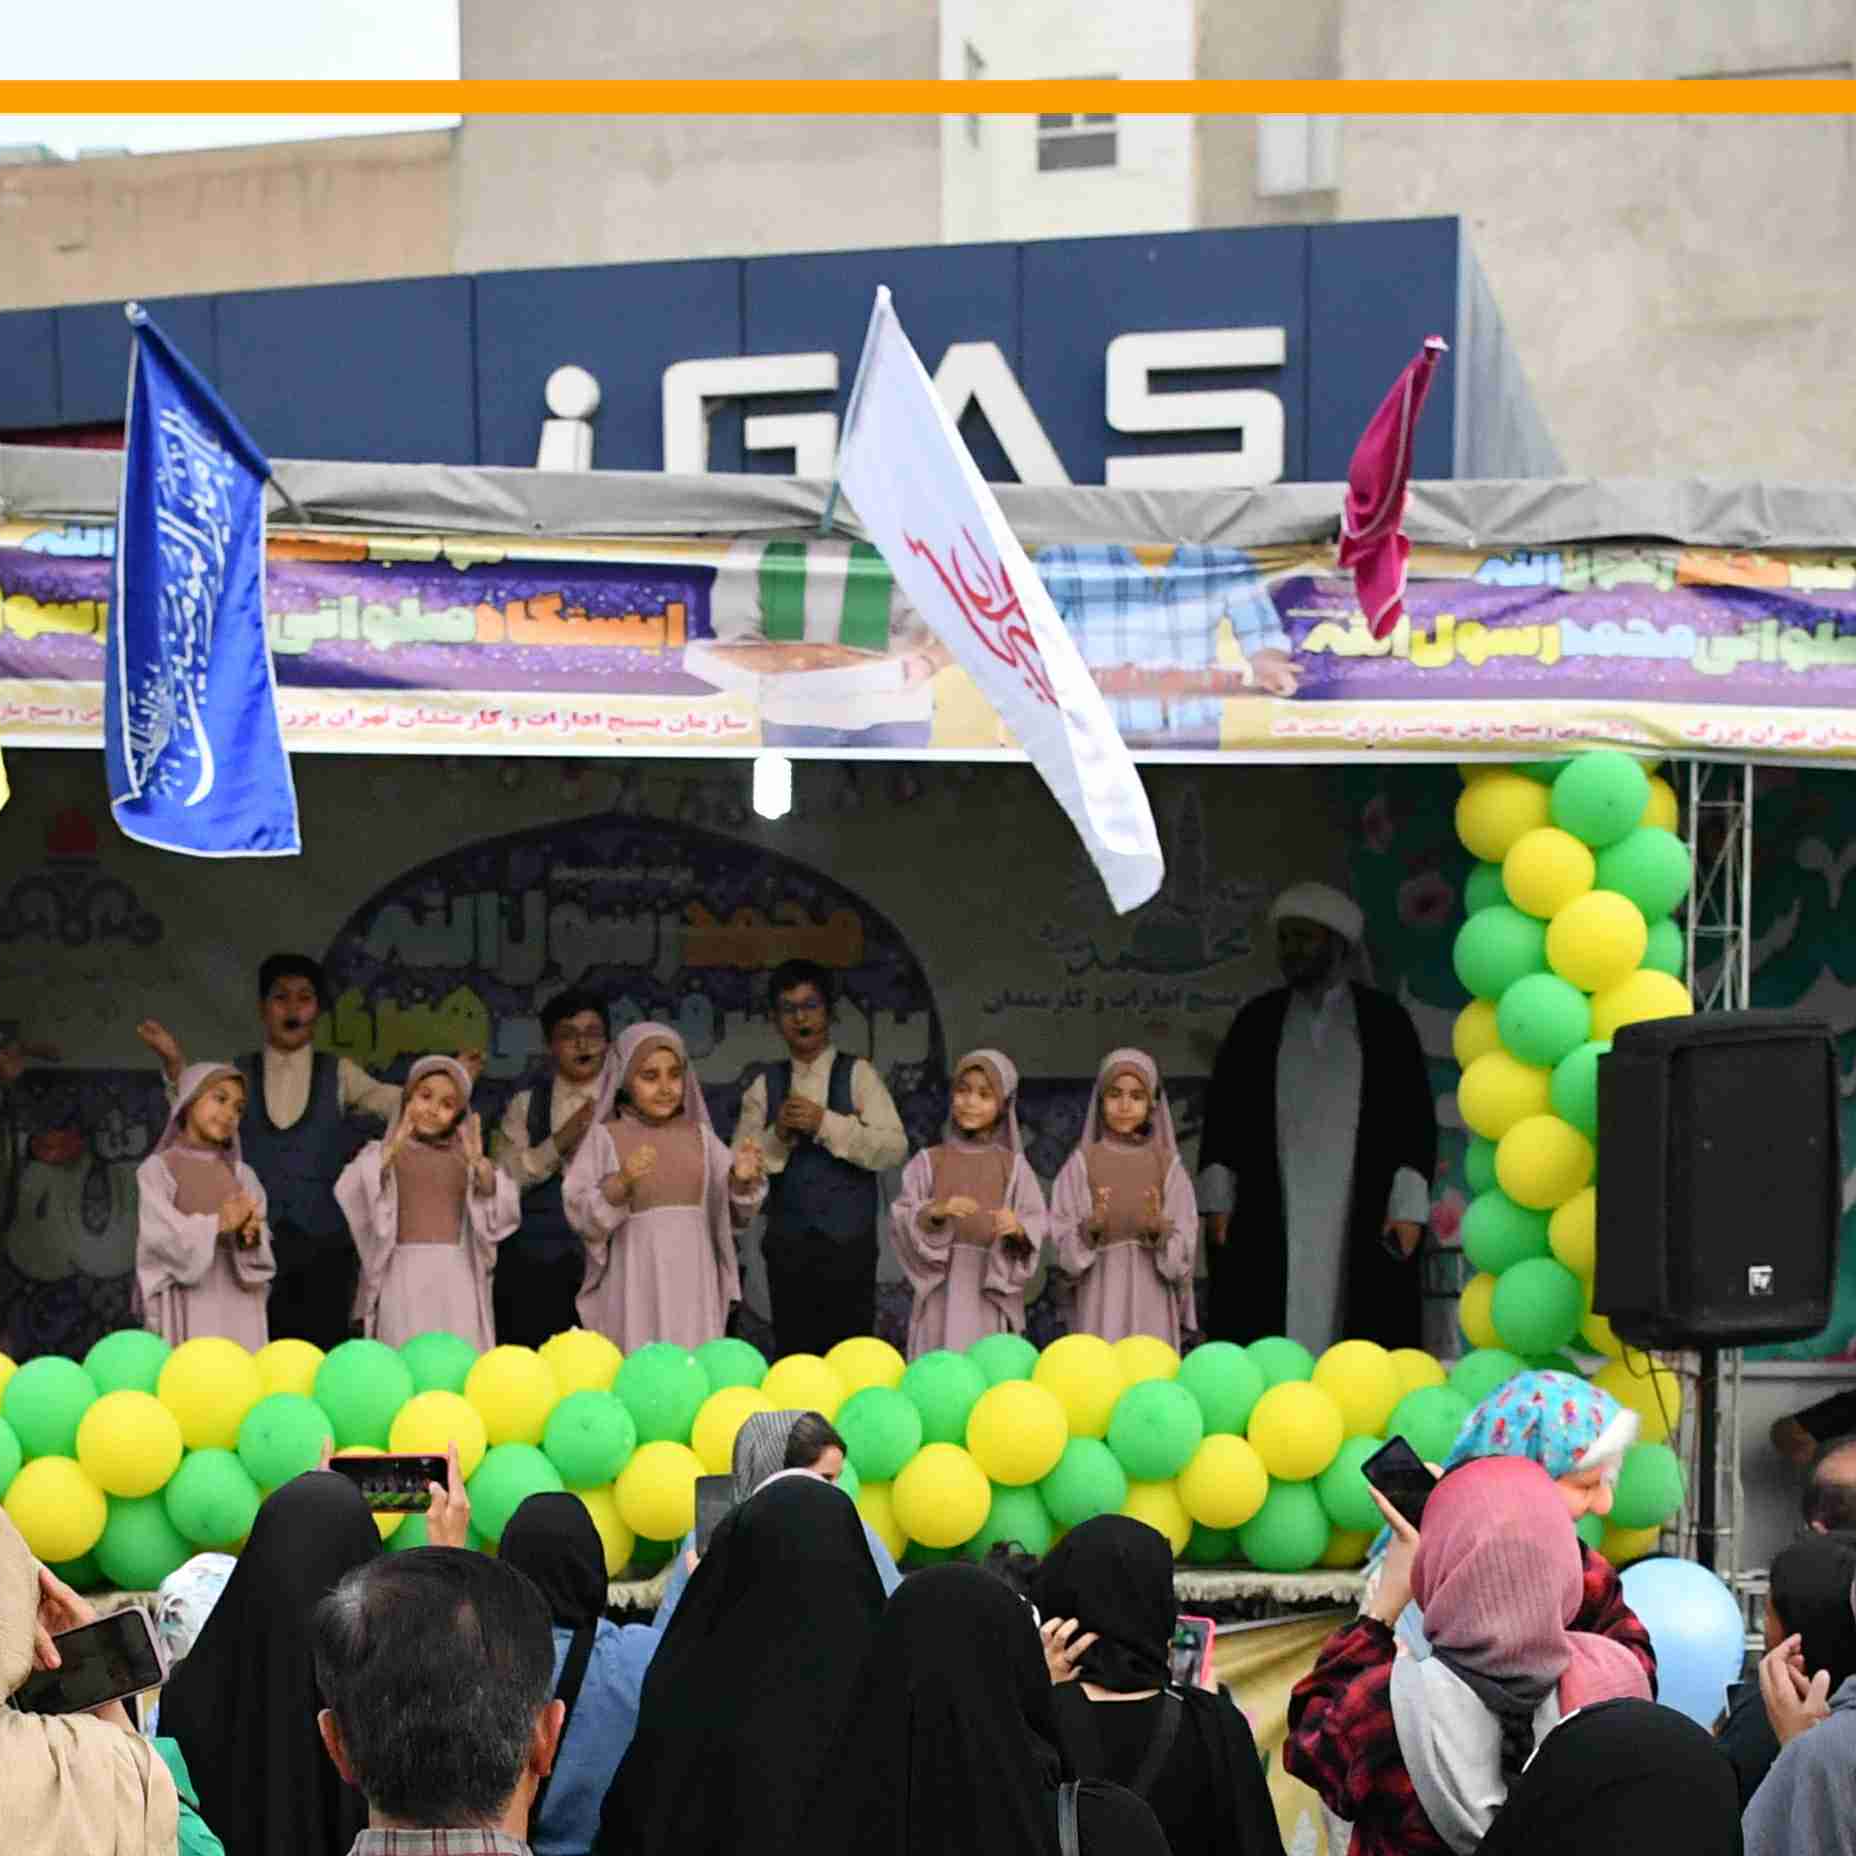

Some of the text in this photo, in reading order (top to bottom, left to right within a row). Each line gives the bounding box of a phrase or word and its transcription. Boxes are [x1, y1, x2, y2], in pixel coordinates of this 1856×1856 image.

[1410, 614, 1560, 668] رسول
[1559, 617, 1696, 659] محمد
[282, 707, 321, 729] بزر
